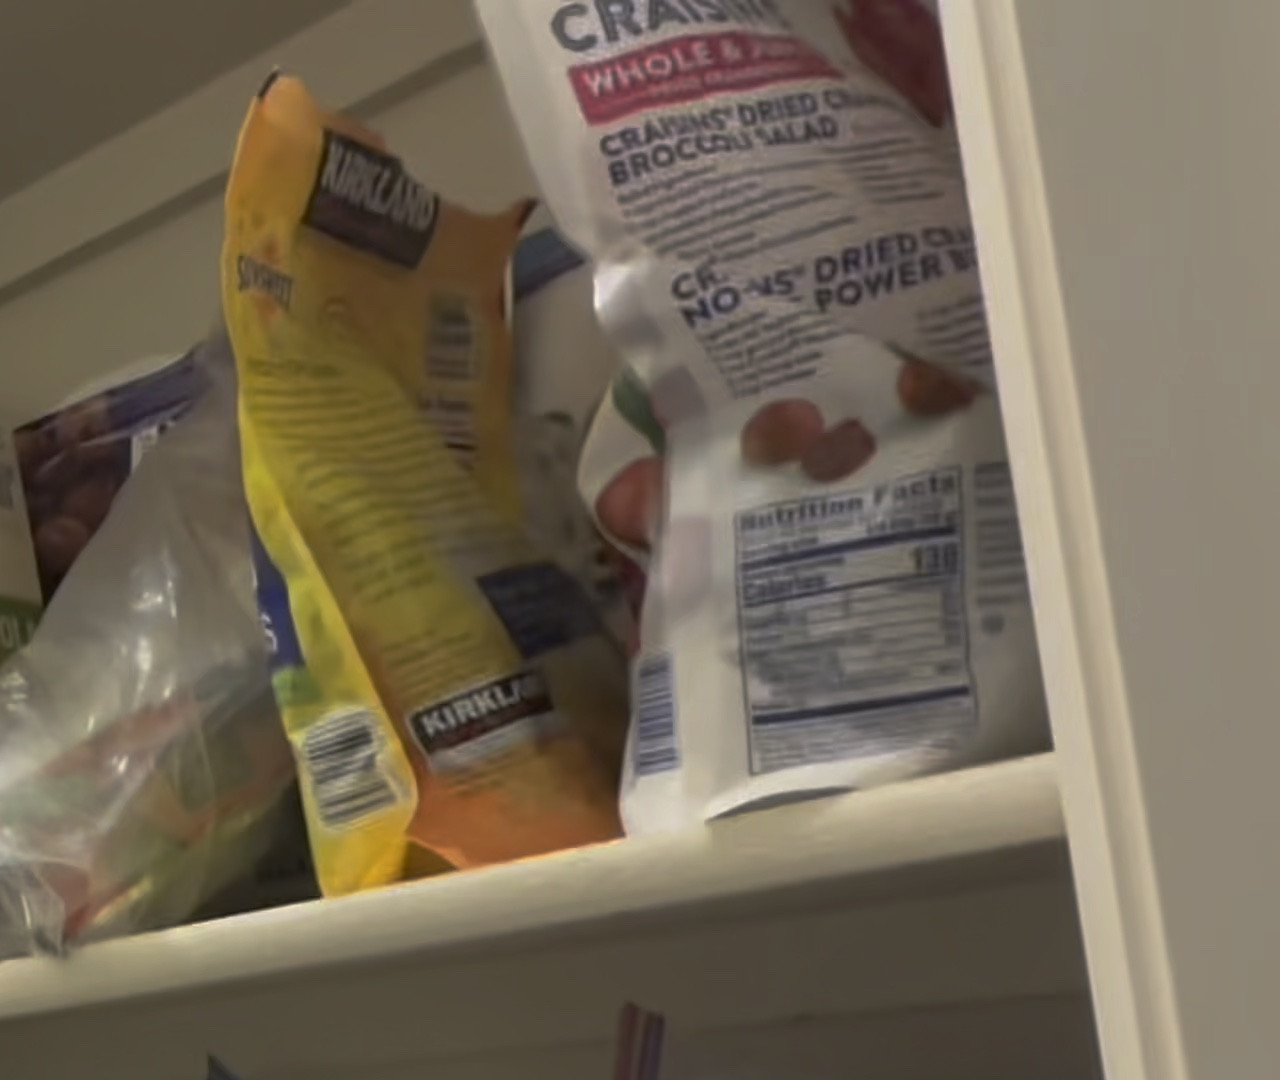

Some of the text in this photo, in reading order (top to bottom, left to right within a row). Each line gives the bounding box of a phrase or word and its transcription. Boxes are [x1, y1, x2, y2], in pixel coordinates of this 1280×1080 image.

[583, 40, 713, 97] WHOLE
[738, 94, 818, 127] DRIED
[321, 138, 434, 232] KIRKLAND
[814, 232, 919, 283] DRIED
[814, 256, 943, 314] POWER
